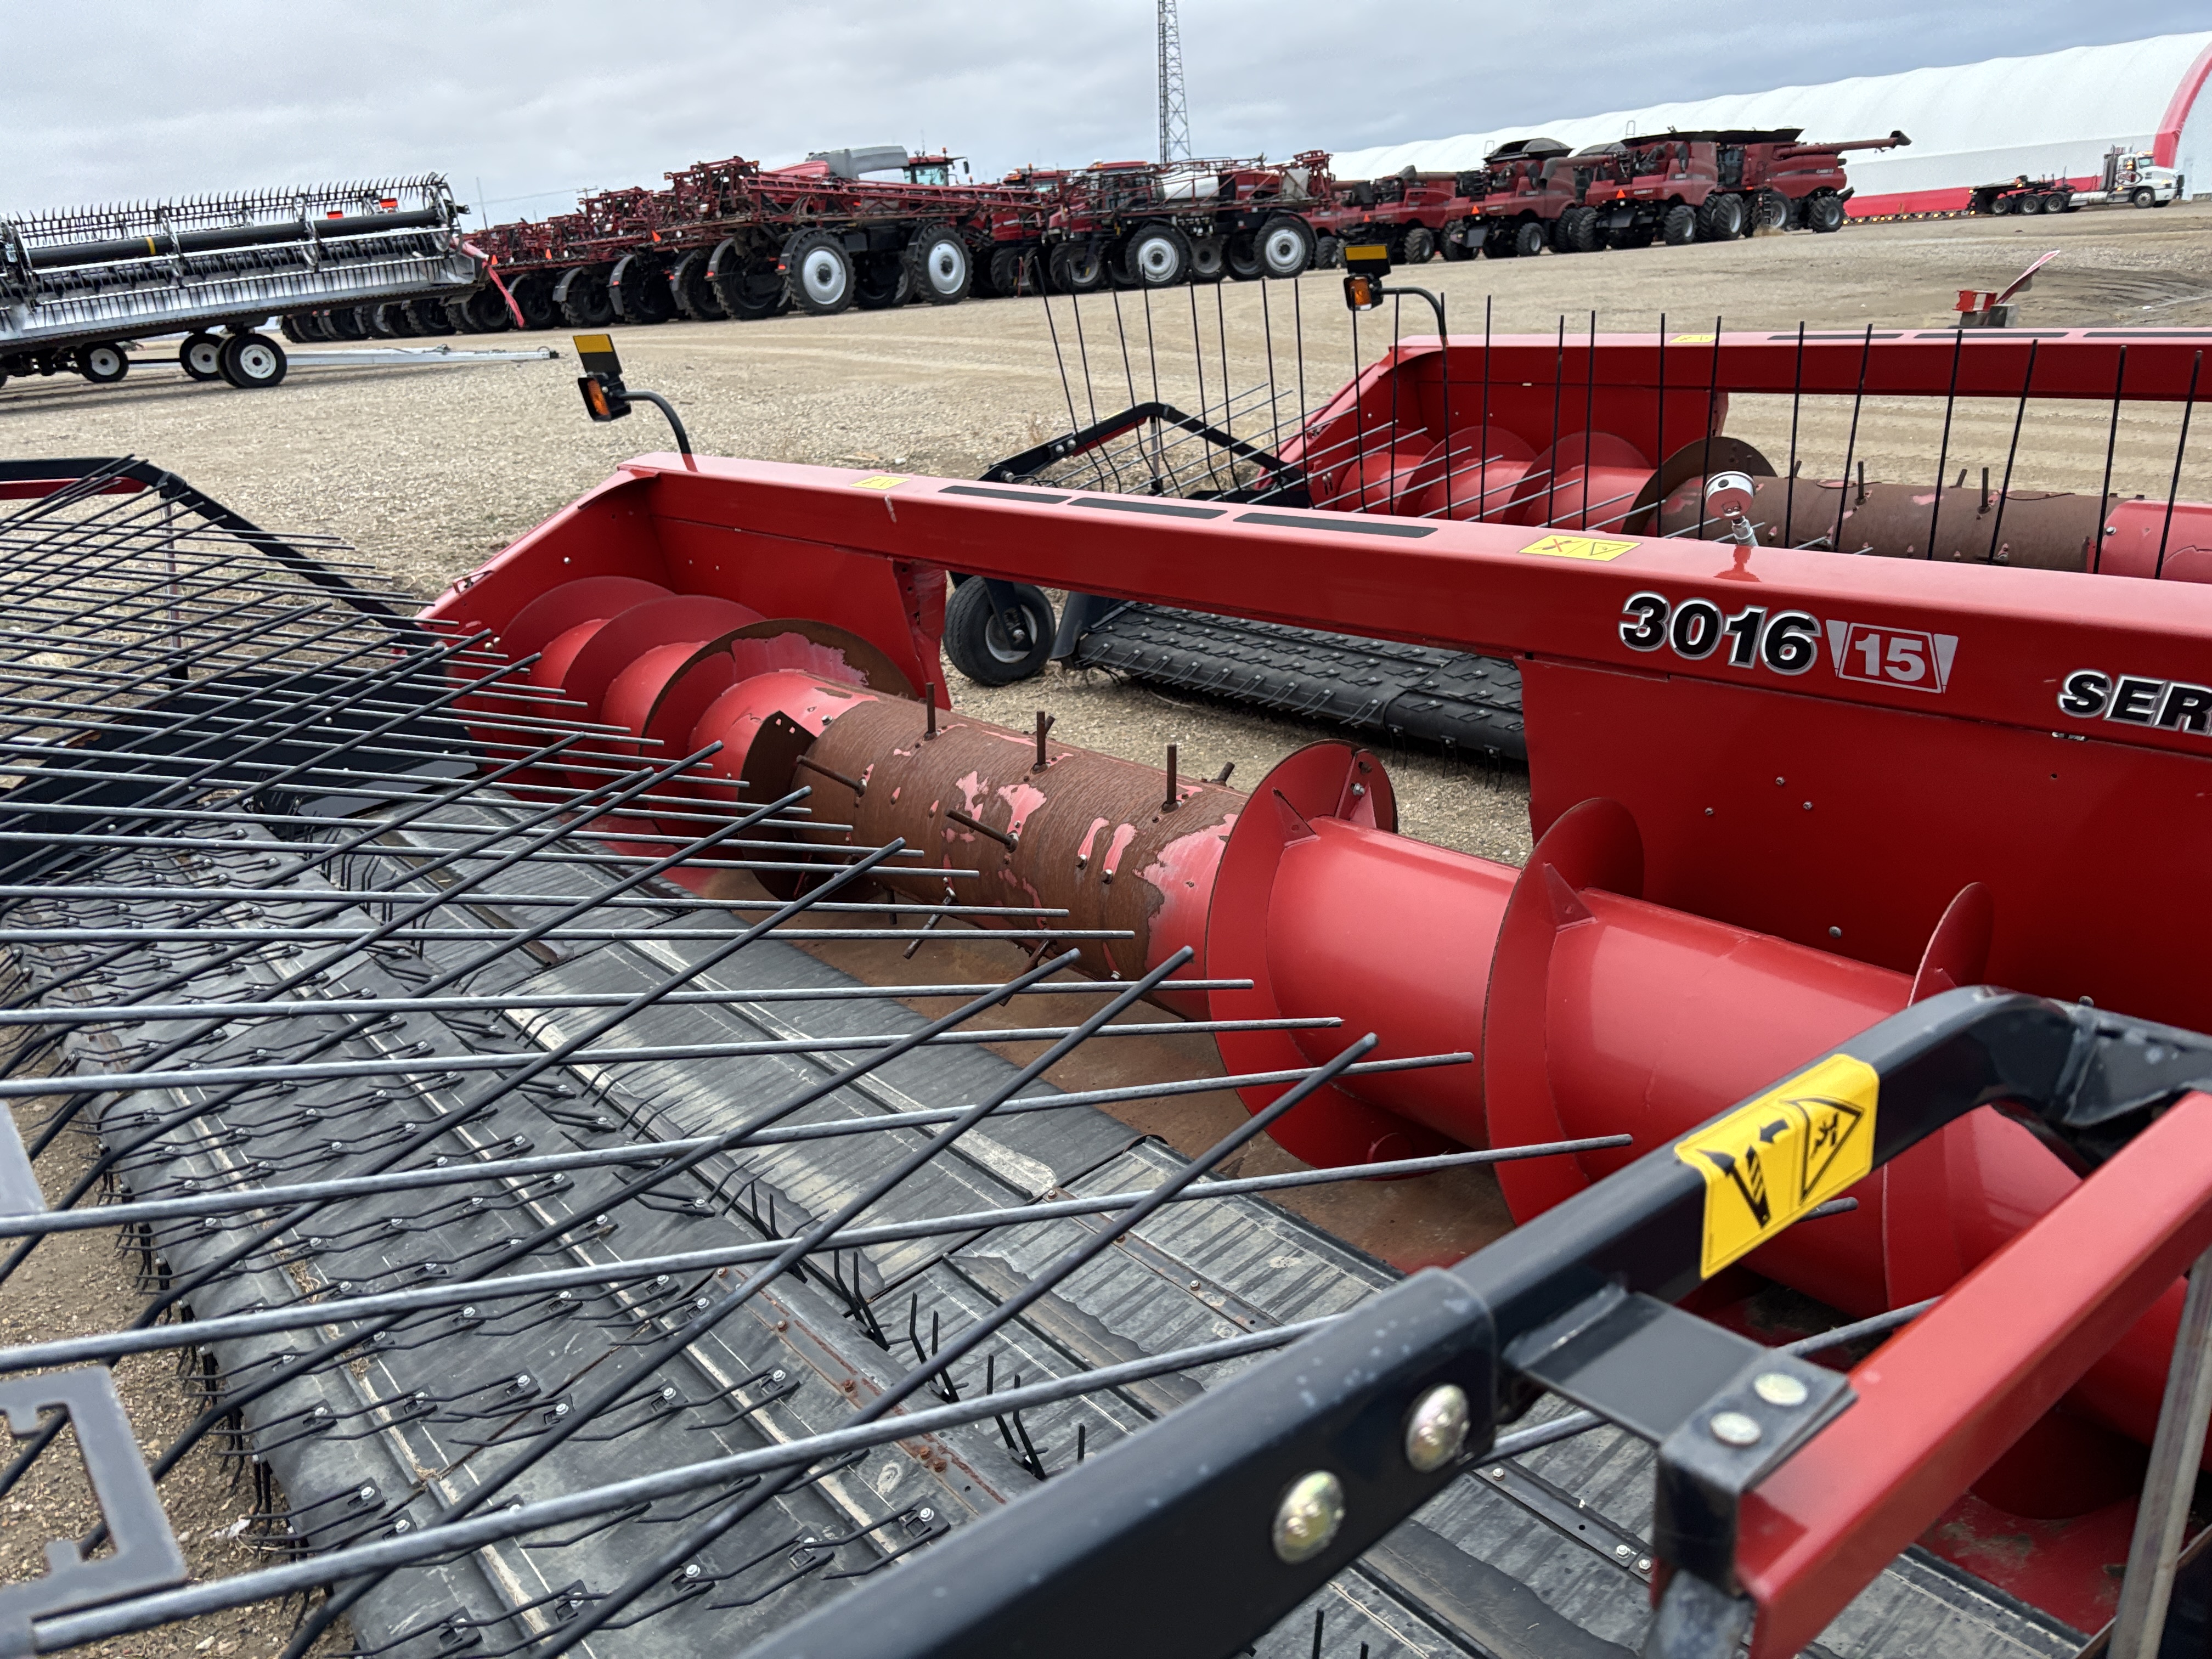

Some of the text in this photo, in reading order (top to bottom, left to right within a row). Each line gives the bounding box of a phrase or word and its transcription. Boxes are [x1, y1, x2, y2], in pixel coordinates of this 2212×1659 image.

[1618, 591, 2212, 737] 3016 15 SER
